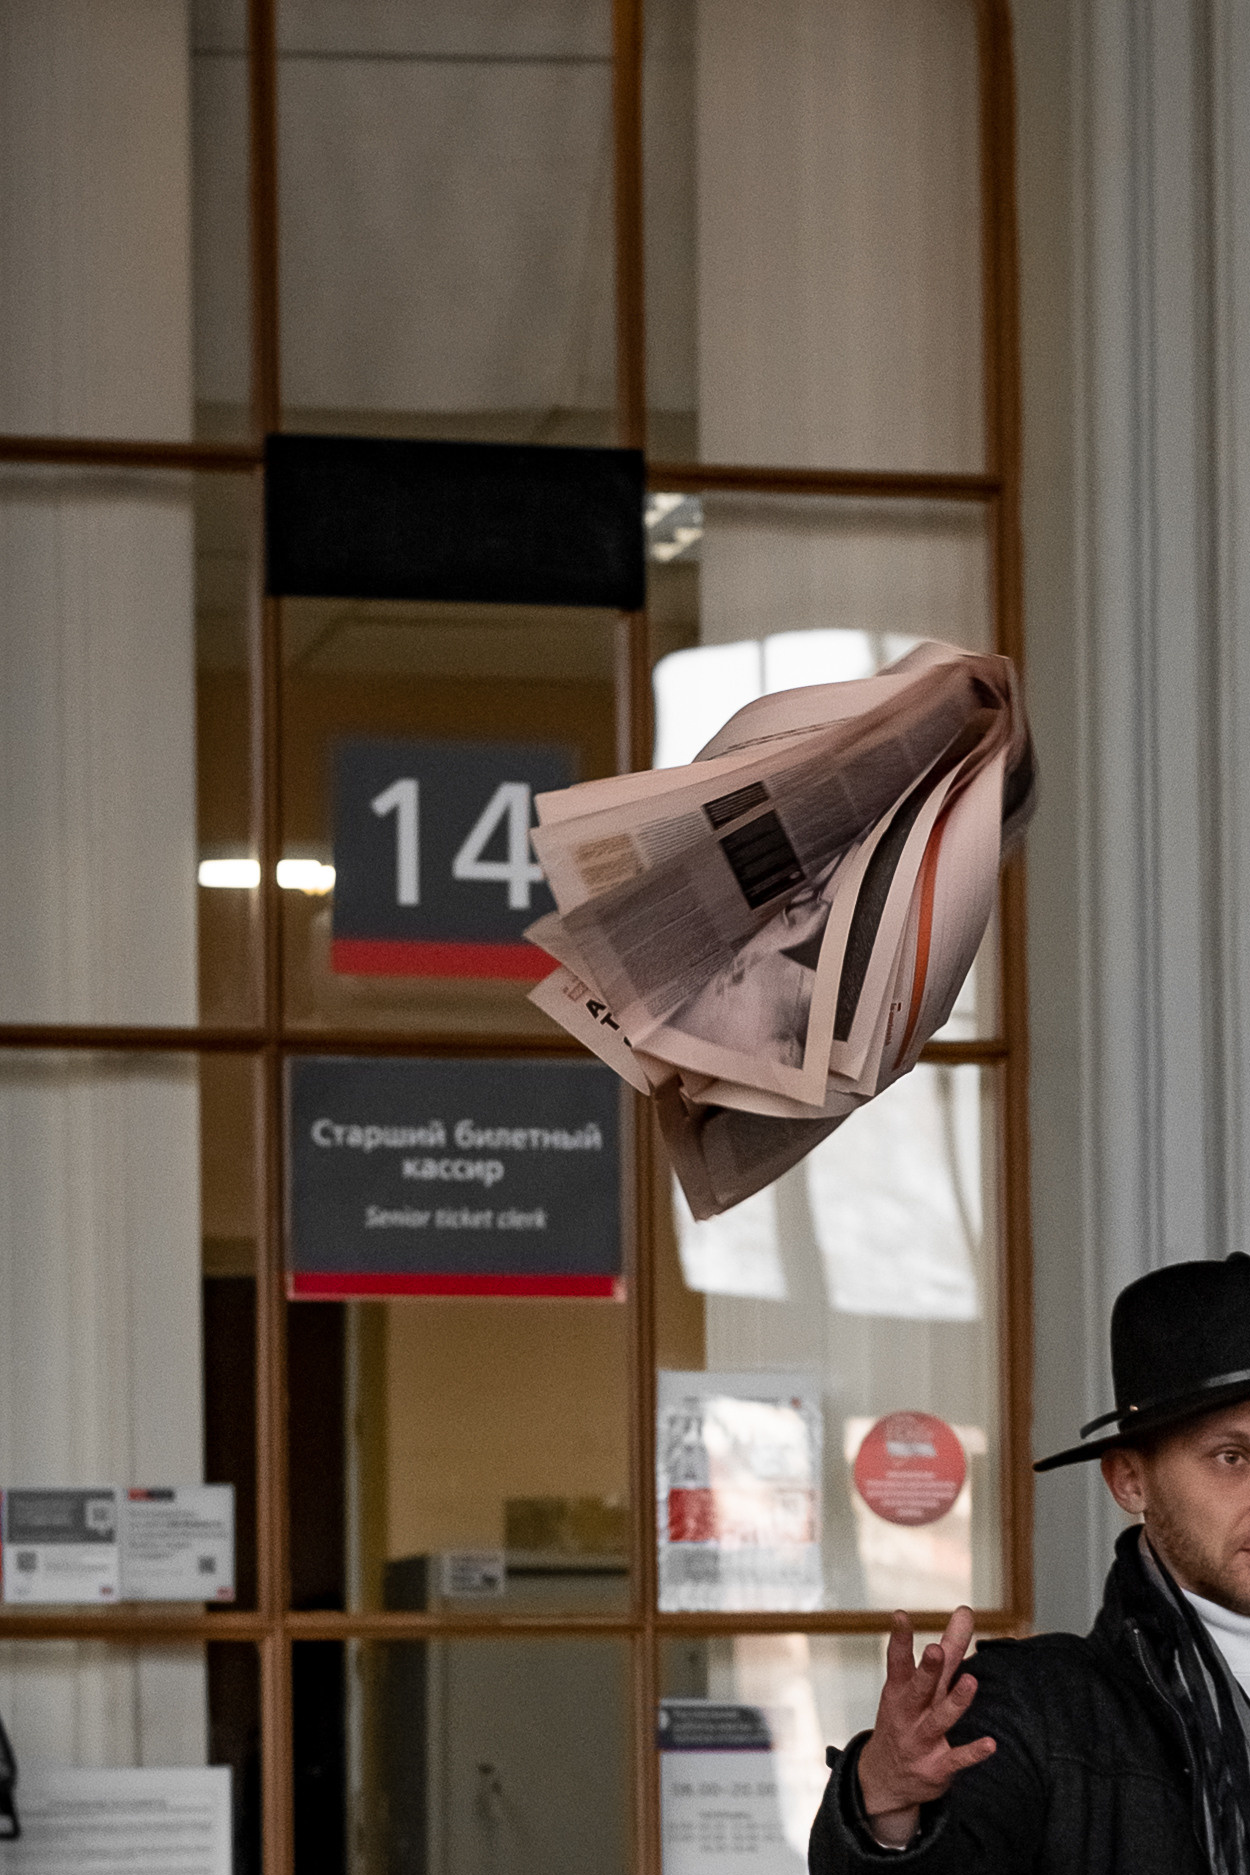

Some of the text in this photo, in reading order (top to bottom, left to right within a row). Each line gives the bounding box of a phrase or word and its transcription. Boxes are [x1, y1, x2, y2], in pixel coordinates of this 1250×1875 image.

[371, 778, 546, 910] 14
[311, 1118, 602, 1152] Старший билетный
[402, 1158, 504, 1187] кассир
[365, 1204, 547, 1231] Senior ticket clerk
